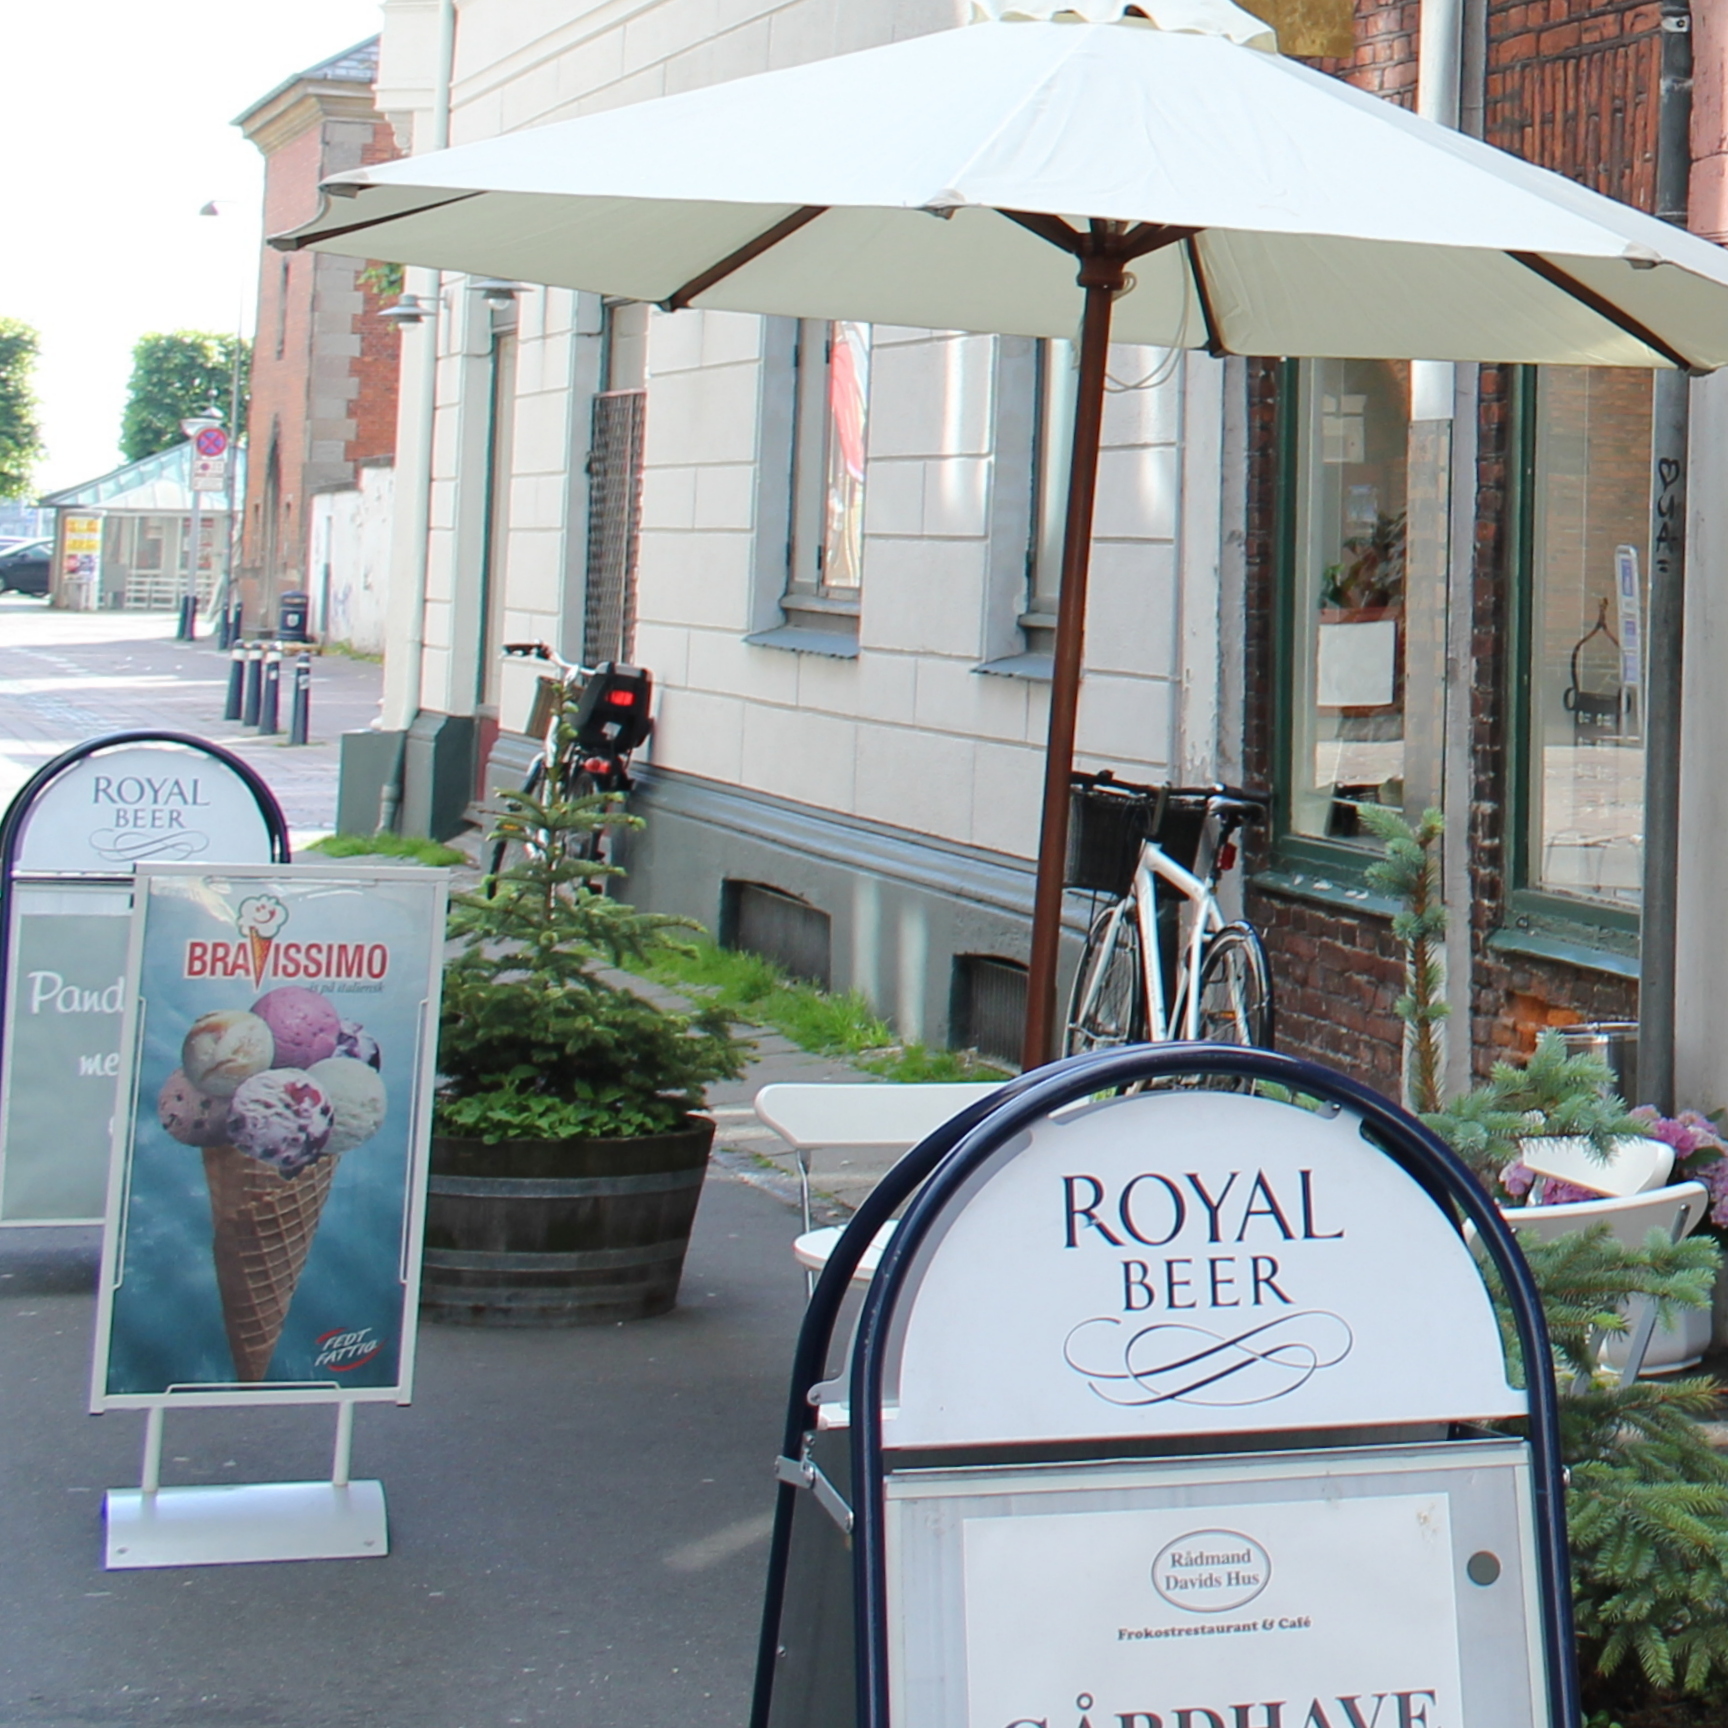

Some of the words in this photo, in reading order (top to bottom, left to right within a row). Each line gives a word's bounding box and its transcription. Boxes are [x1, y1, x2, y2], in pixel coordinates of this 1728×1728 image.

[93, 776, 211, 806] ROYAL
[115, 808, 187, 829] BEER
[27, 970, 125, 1014] Pand
[1061, 1169, 1344, 1248] ROYAL
[1121, 1256, 1295, 1312] BEER
[322, 1327, 373, 1351] FEDT
[1170, 1548, 1252, 1569] Rådmand
[1164, 1572, 1222, 1592] Davids
[1226, 1570, 1260, 1587] Hus
[1117, 1620, 1259, 1641] Frokostrestaurant
[1262, 1618, 1275, 1631] &
[1278, 1616, 1312, 1630] Café
